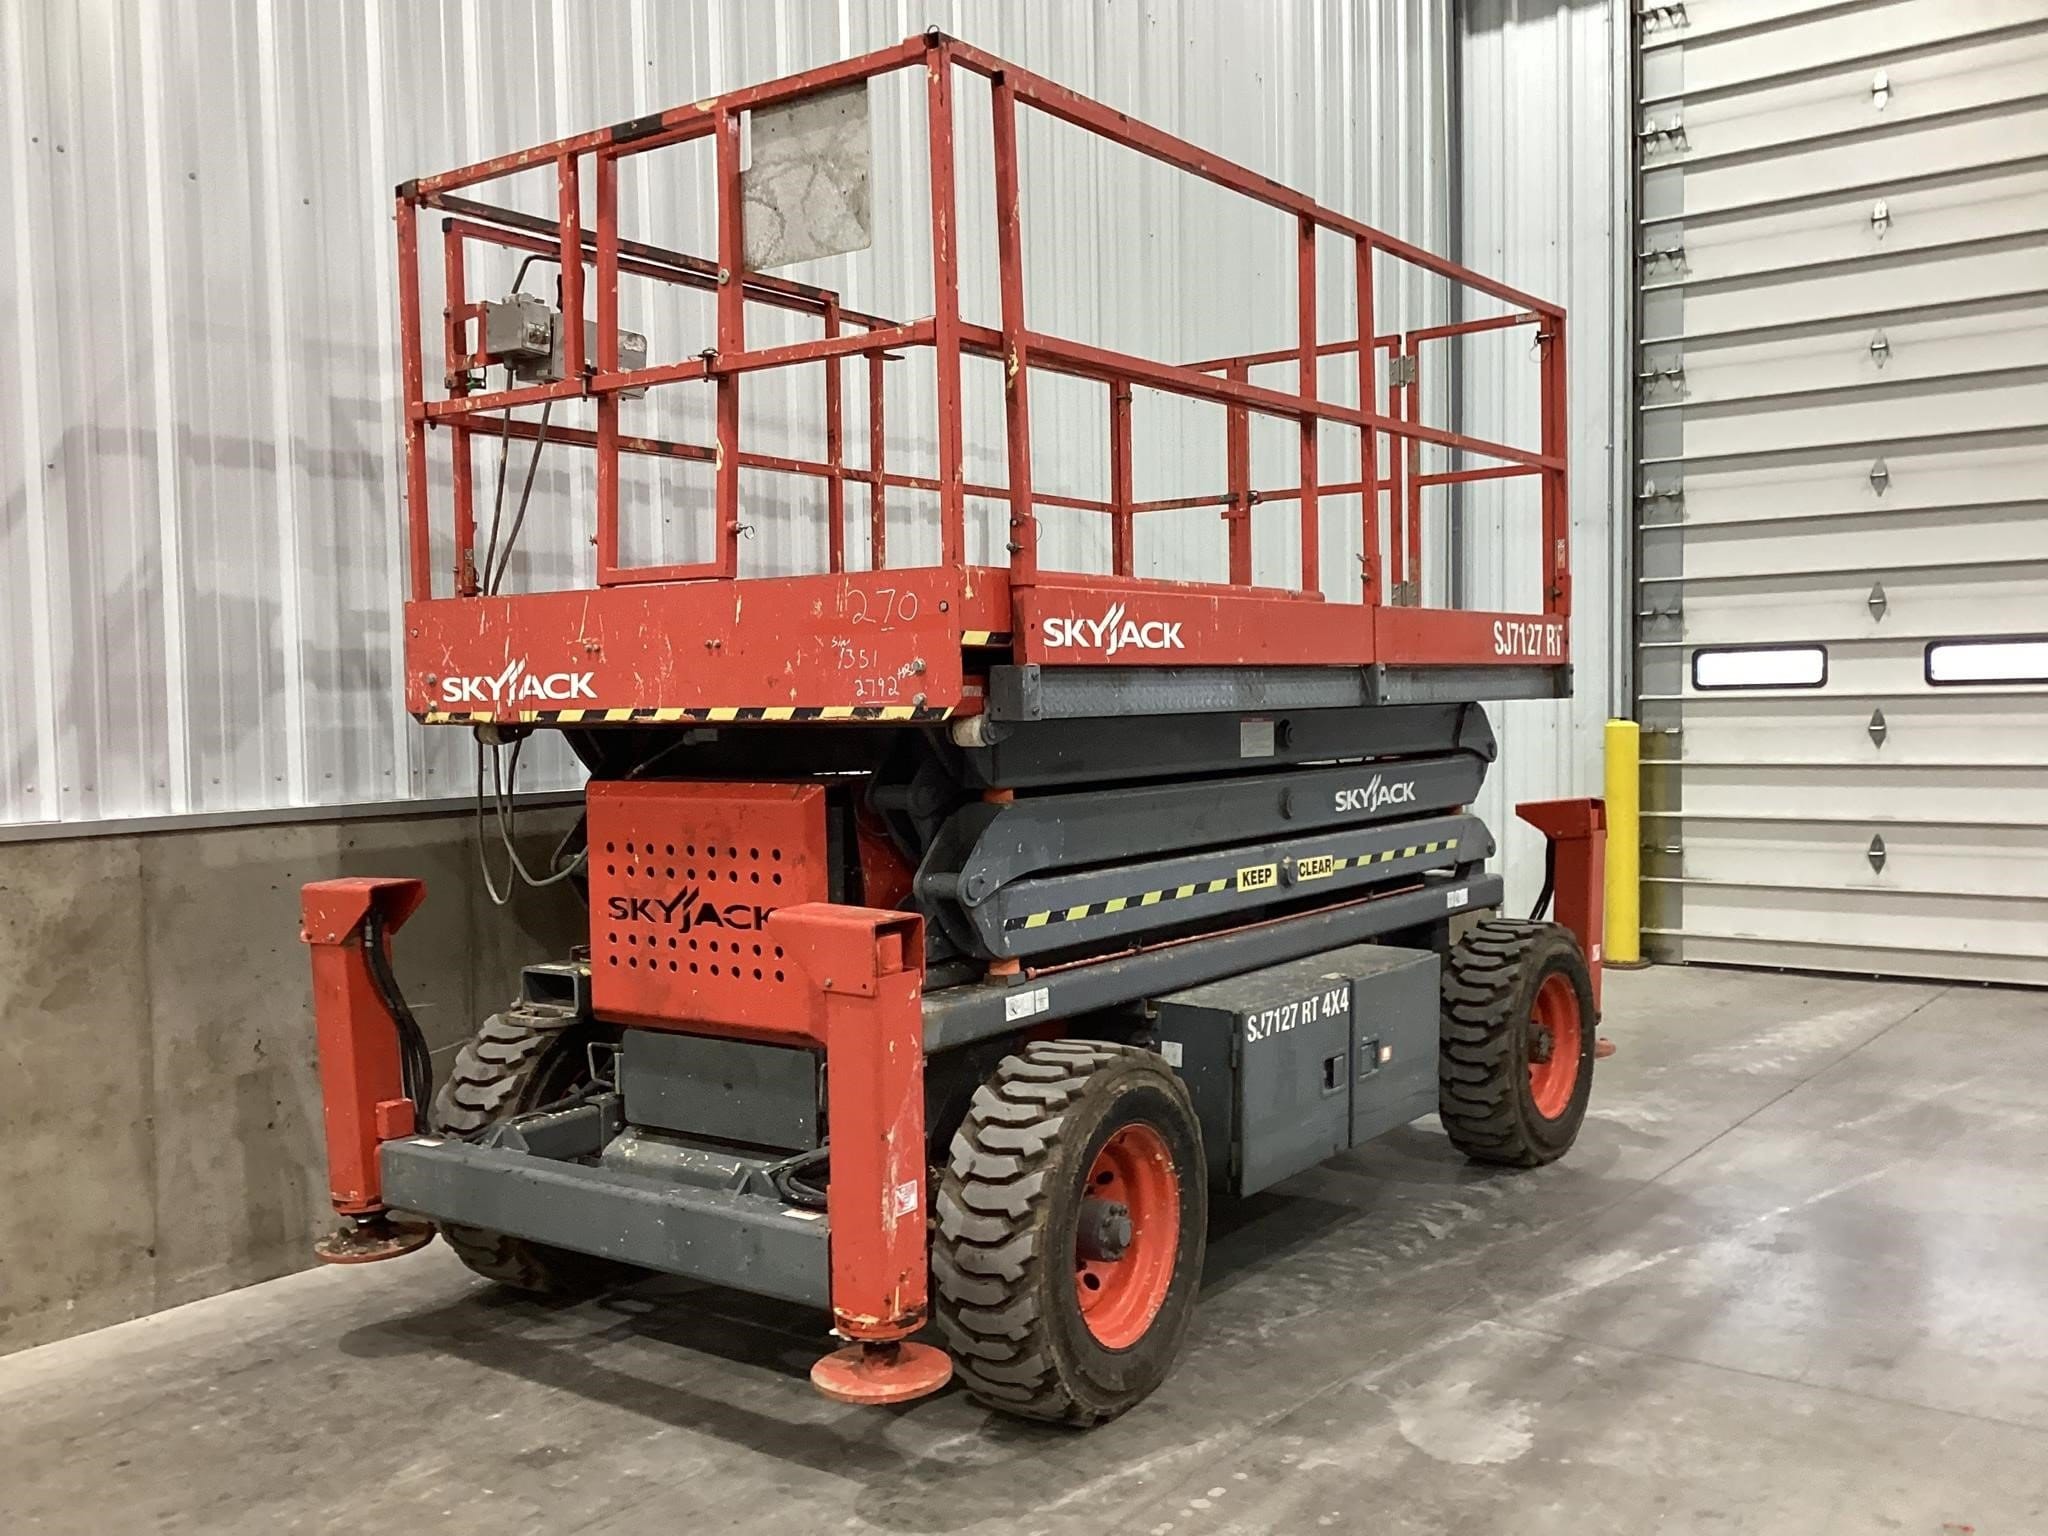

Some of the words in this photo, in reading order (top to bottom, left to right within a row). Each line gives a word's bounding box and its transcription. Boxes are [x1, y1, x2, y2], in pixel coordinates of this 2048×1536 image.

[1043, 601, 1185, 656] SKYJACK
[1493, 620, 1543, 656] SJ7127
[1546, 624, 1563, 656] RT
[441, 658, 598, 707] SKYJACK
[1335, 773, 1416, 812] SKYJACK
[1242, 868, 1272, 887] KEEP
[1299, 858, 1332, 877] CLEAR
[1247, 1002, 1299, 1043] SJ7127
[1301, 996, 1319, 1025] RT
[1322, 987, 1349, 1018] 4X4
